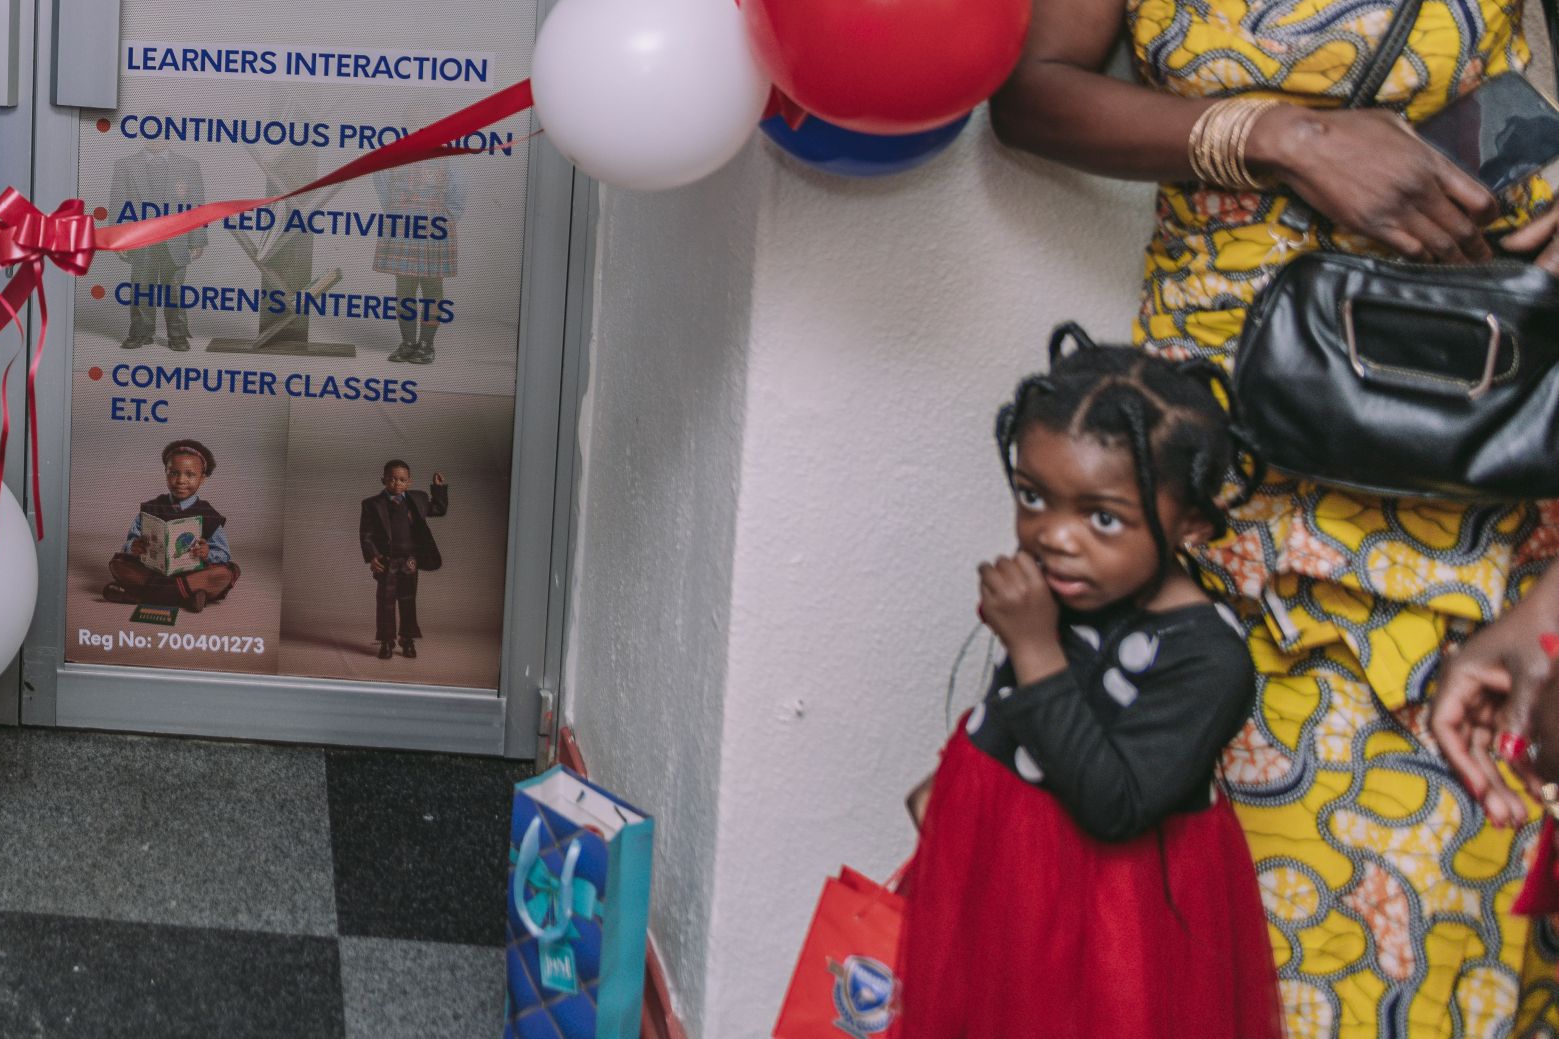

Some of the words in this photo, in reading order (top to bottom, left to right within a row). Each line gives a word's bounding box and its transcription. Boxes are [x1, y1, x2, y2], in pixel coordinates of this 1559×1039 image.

[127, 46, 278, 76] LEARNERS
[285, 51, 489, 83] INTERACTION
[120, 114, 330, 149] CONTINUOUS
[283, 209, 449, 241] ACTIVITIES
[295, 291, 455, 324] INTERESTS
[111, 363, 278, 396] COMPUTER
[284, 372, 418, 404] CLASSES
[111, 397, 170, 424] E.T.C
[78, 628, 113, 651] Reg
[118, 630, 153, 649] No:
[157, 632, 265, 654] 700401273
